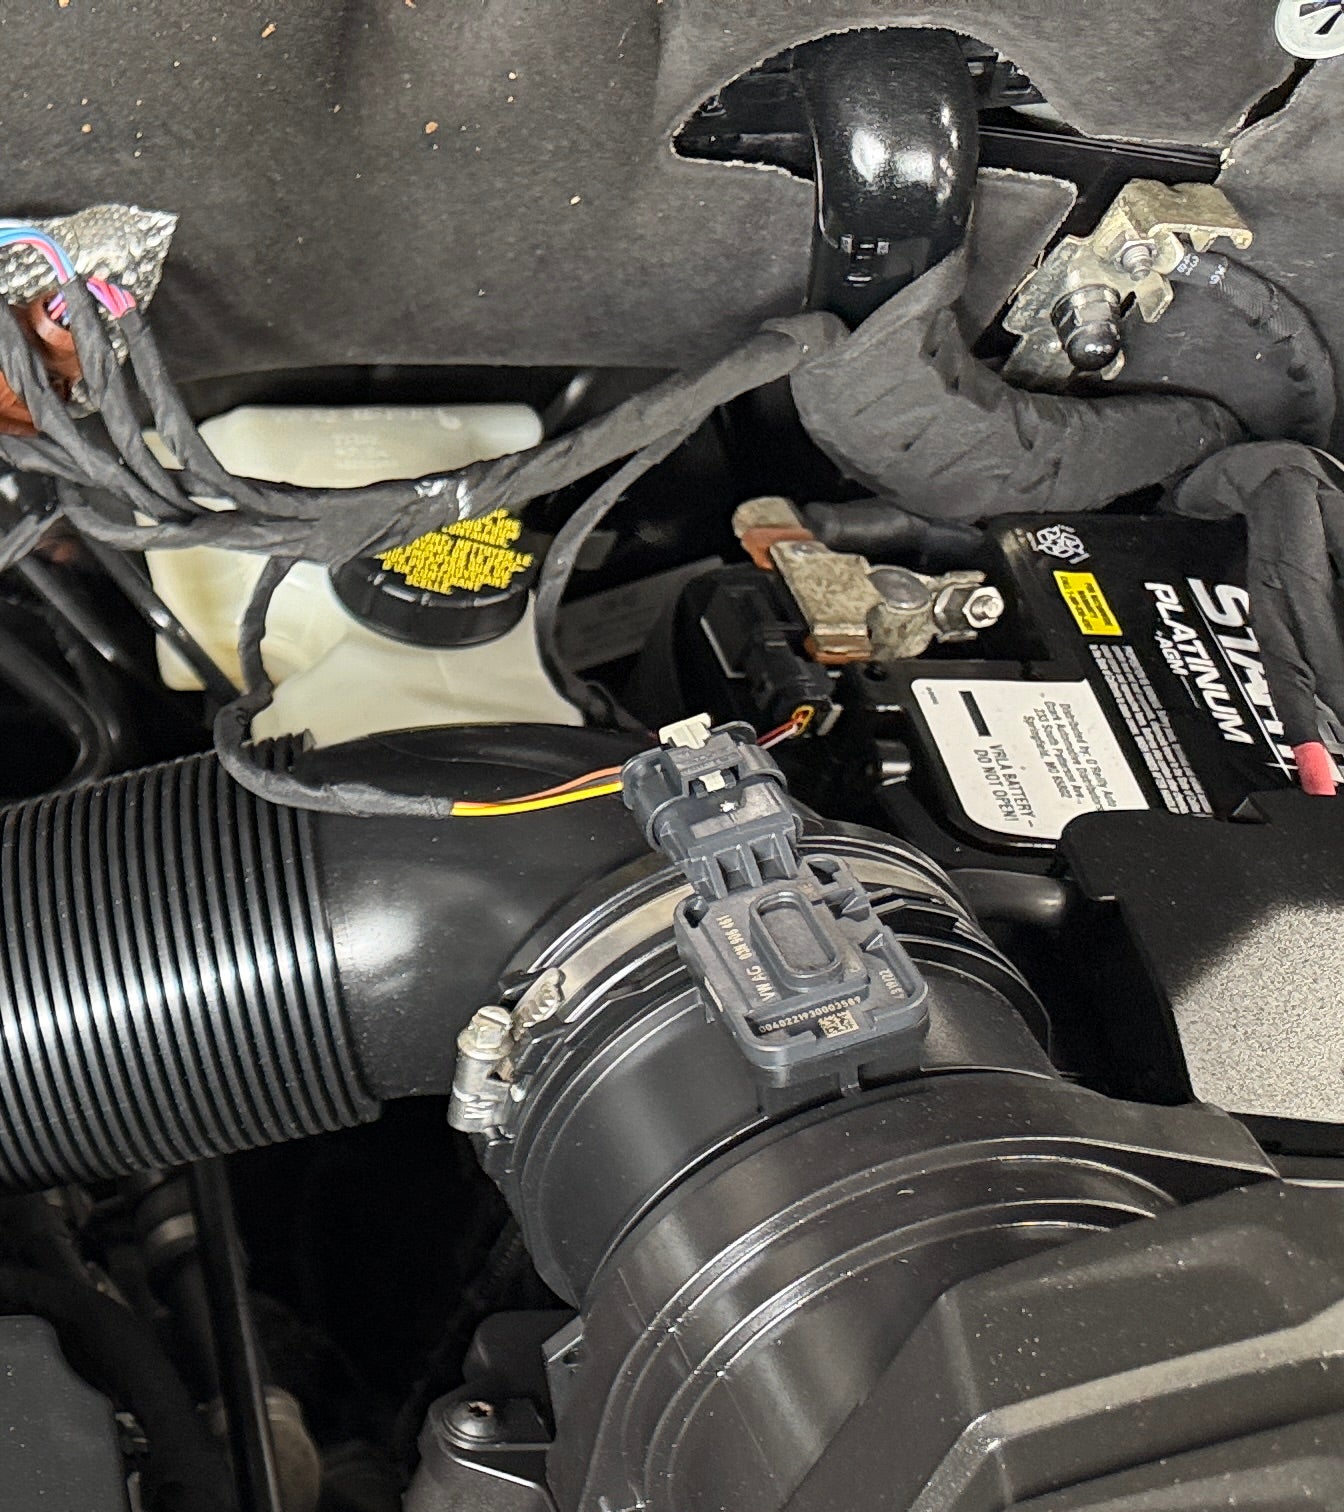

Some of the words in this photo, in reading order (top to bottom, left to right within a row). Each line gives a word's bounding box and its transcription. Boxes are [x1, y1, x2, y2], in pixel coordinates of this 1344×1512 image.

[1145, 582, 1254, 744] PLATINUM
[1156, 636, 1189, 676] AGM
[972, 749, 991, 764] DO
[981, 766, 1003, 788] NOT
[989, 744, 1012, 772] VRLA
[1002, 772, 1035, 818] BATTERY
[745, 963, 766, 984] AG
[754, 980, 775, 1001] VW
